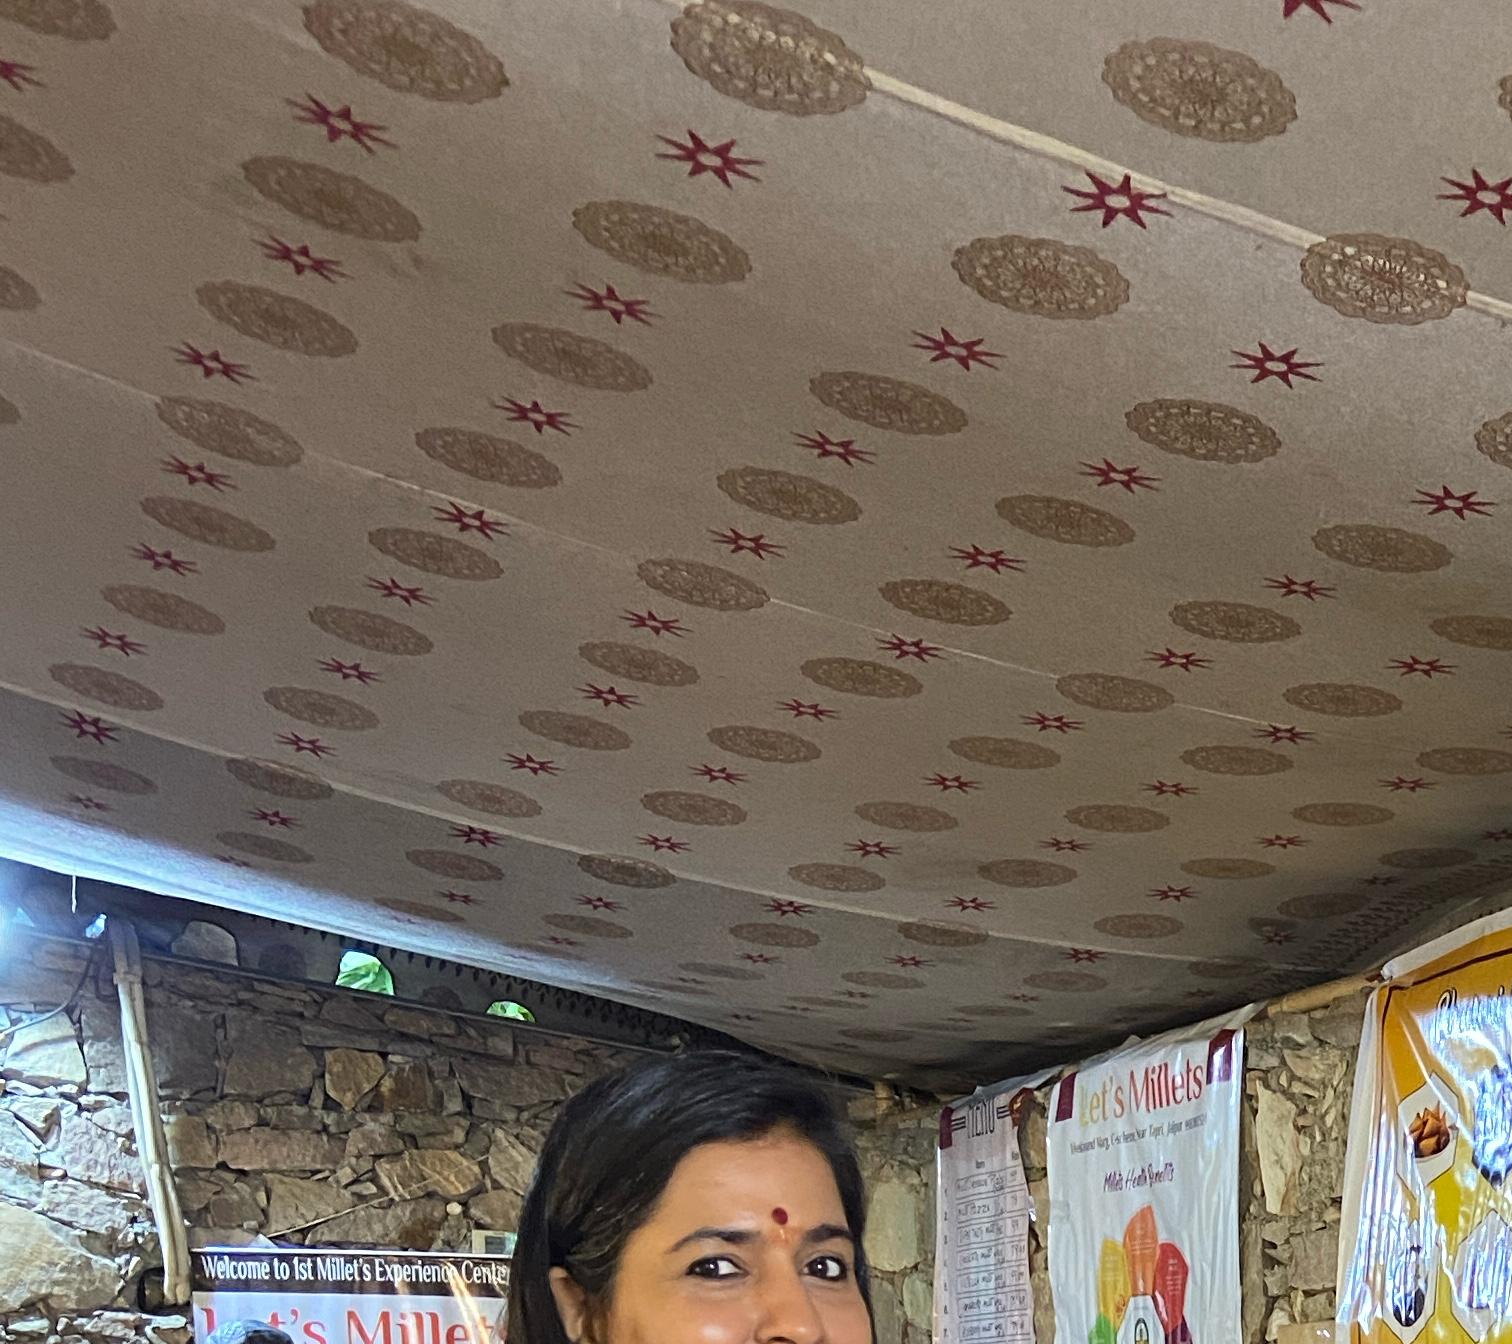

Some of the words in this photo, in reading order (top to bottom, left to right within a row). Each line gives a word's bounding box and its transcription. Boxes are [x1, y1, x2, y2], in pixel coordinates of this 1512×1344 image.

[1129, 1058, 1203, 1113] Millets
[201, 1255, 270, 1281] Welcome
[273, 1259, 290, 1281] to
[293, 1257, 314, 1281] 1st
[316, 1258, 371, 1282] Millet's
